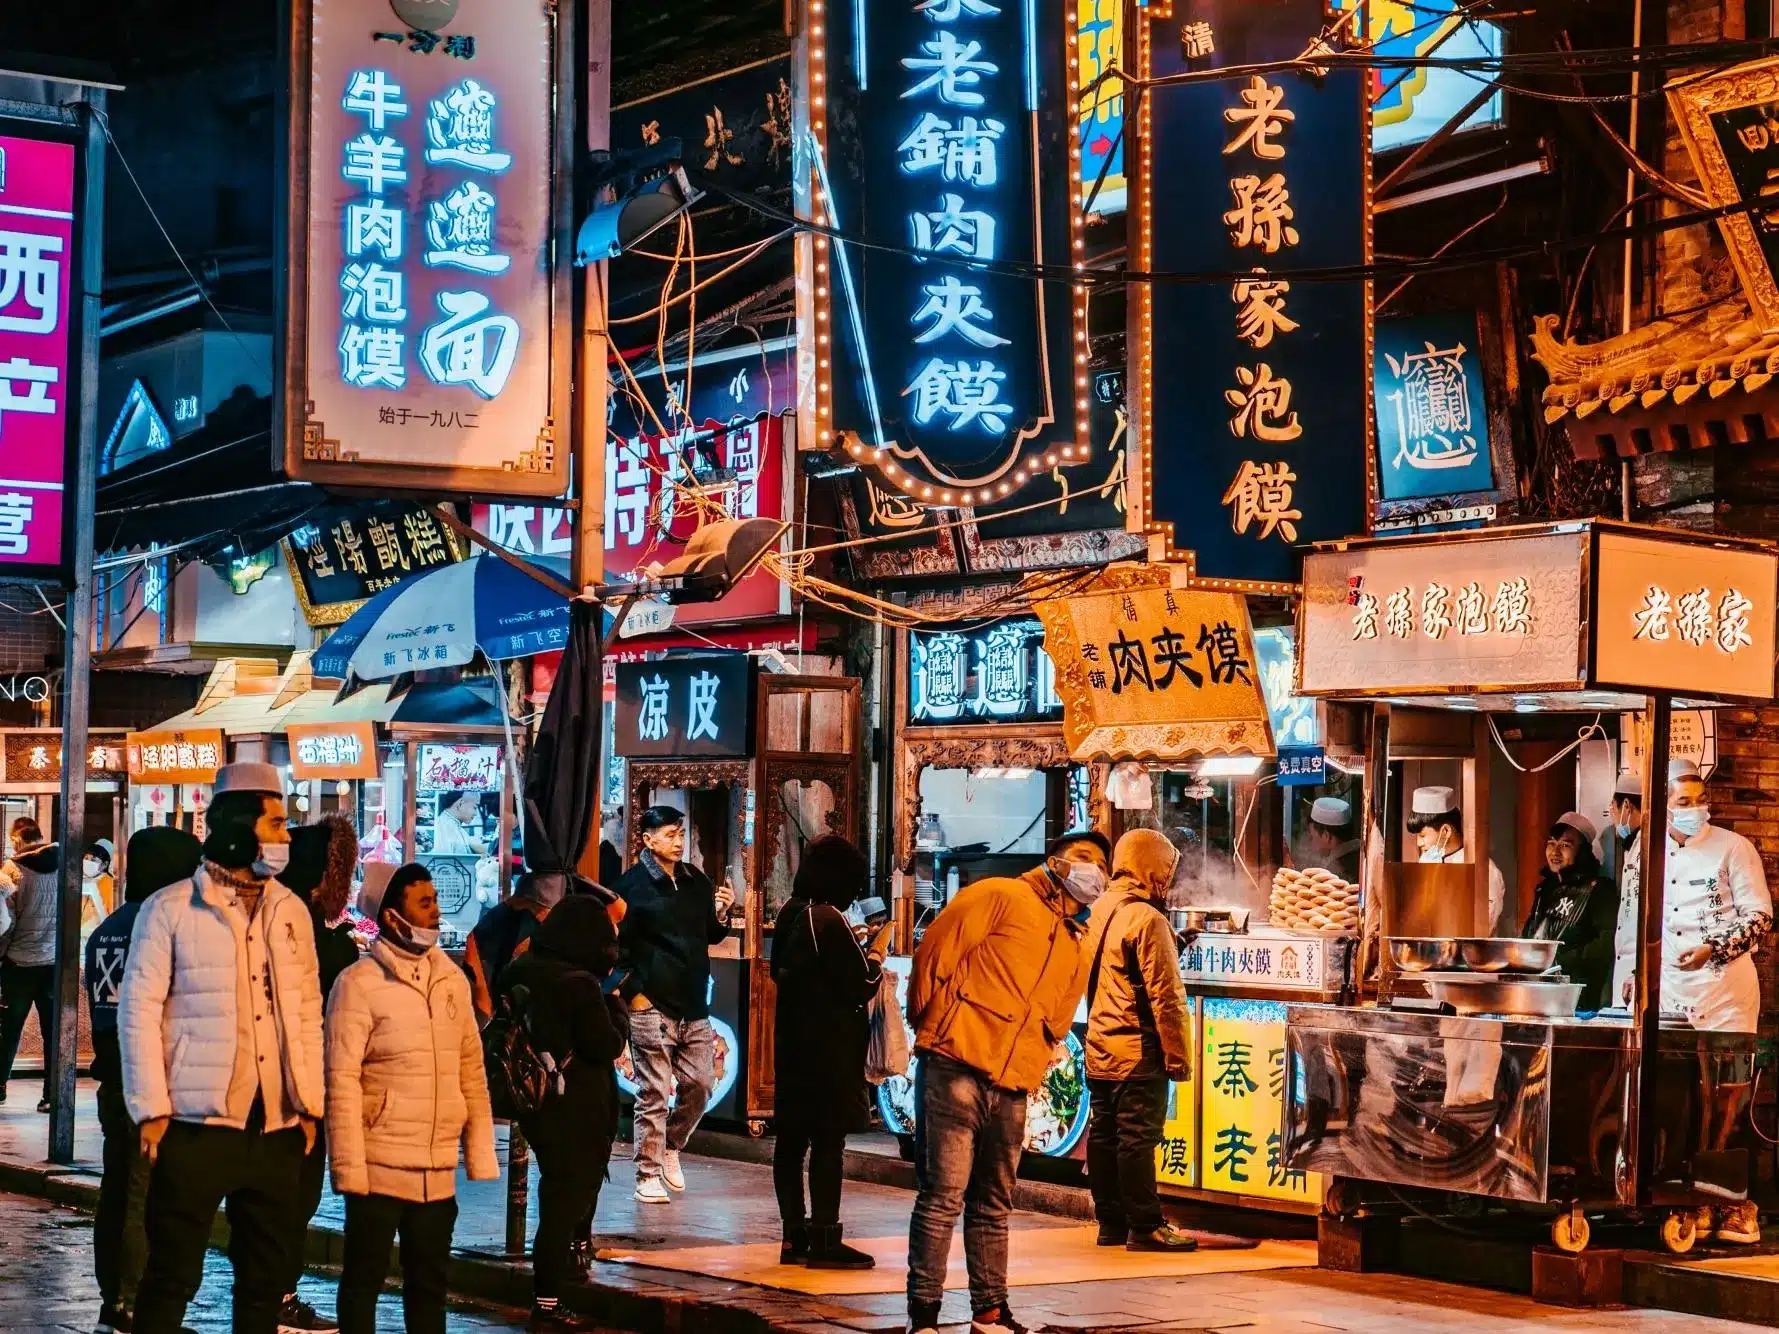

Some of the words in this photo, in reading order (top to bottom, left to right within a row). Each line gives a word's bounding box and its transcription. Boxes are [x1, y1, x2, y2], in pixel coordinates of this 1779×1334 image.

[339, 71, 408, 390] 牛羊肉泡馍
[378, 407, 480, 430] 始于一九八二
[384, 644, 448, 666] 新飞冰箱
[511, 626, 570, 650] 新飞空
[1108, 620, 1253, 695] 肉夹馍
[638, 670, 721, 741] 凉皮
